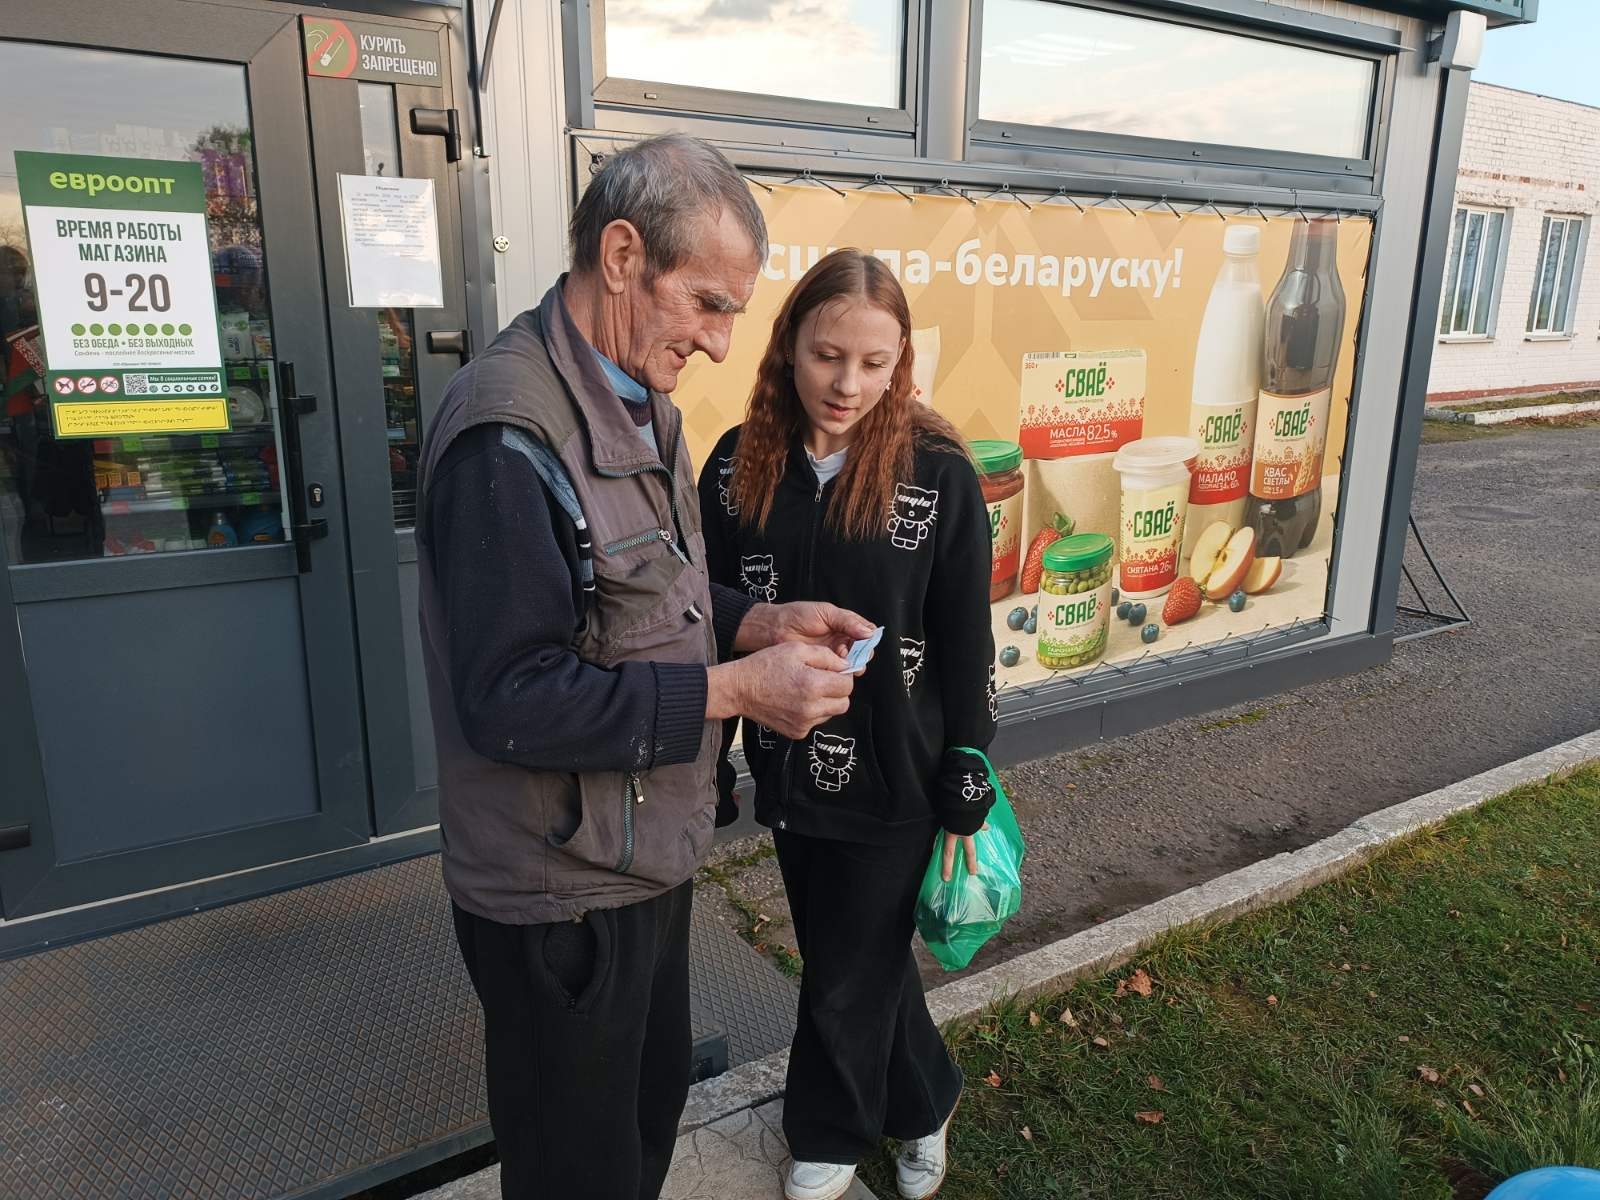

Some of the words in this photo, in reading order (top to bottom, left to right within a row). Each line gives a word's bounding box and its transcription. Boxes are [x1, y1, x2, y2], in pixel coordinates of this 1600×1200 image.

[360, 34, 406, 54] КУРИТЬ
[362, 54, 438, 77] ЗАПРЕЩЕНО!
[50, 171, 175, 196] евроопт
[56, 219, 113, 239] ВРЕМЯ
[117, 222, 182, 241] РАБОТЫ
[78, 243, 167, 263] МАГАЗИНА
[84, 272, 171, 312] 9-20
[73, 339, 91, 349] БЕЗ
[92, 339, 119, 349] ОБЕДА
[128, 339, 144, 348] БЕЗ
[146, 338, 194, 348] ВЫХОДНЫХ
[1065, 362, 1107, 398] СВАЁ
[1205, 408, 1242, 443] СВАЁ
[1274, 402, 1310, 437] СВАЁ
[1050, 428, 1086, 439] МАСЛА
[1199, 471, 1237, 483] МАЛАКО
[1264, 467, 1287, 478] КВАС
[1134, 501, 1175, 538] СВАЁ
[1055, 593, 1097, 626] СВАЁ
